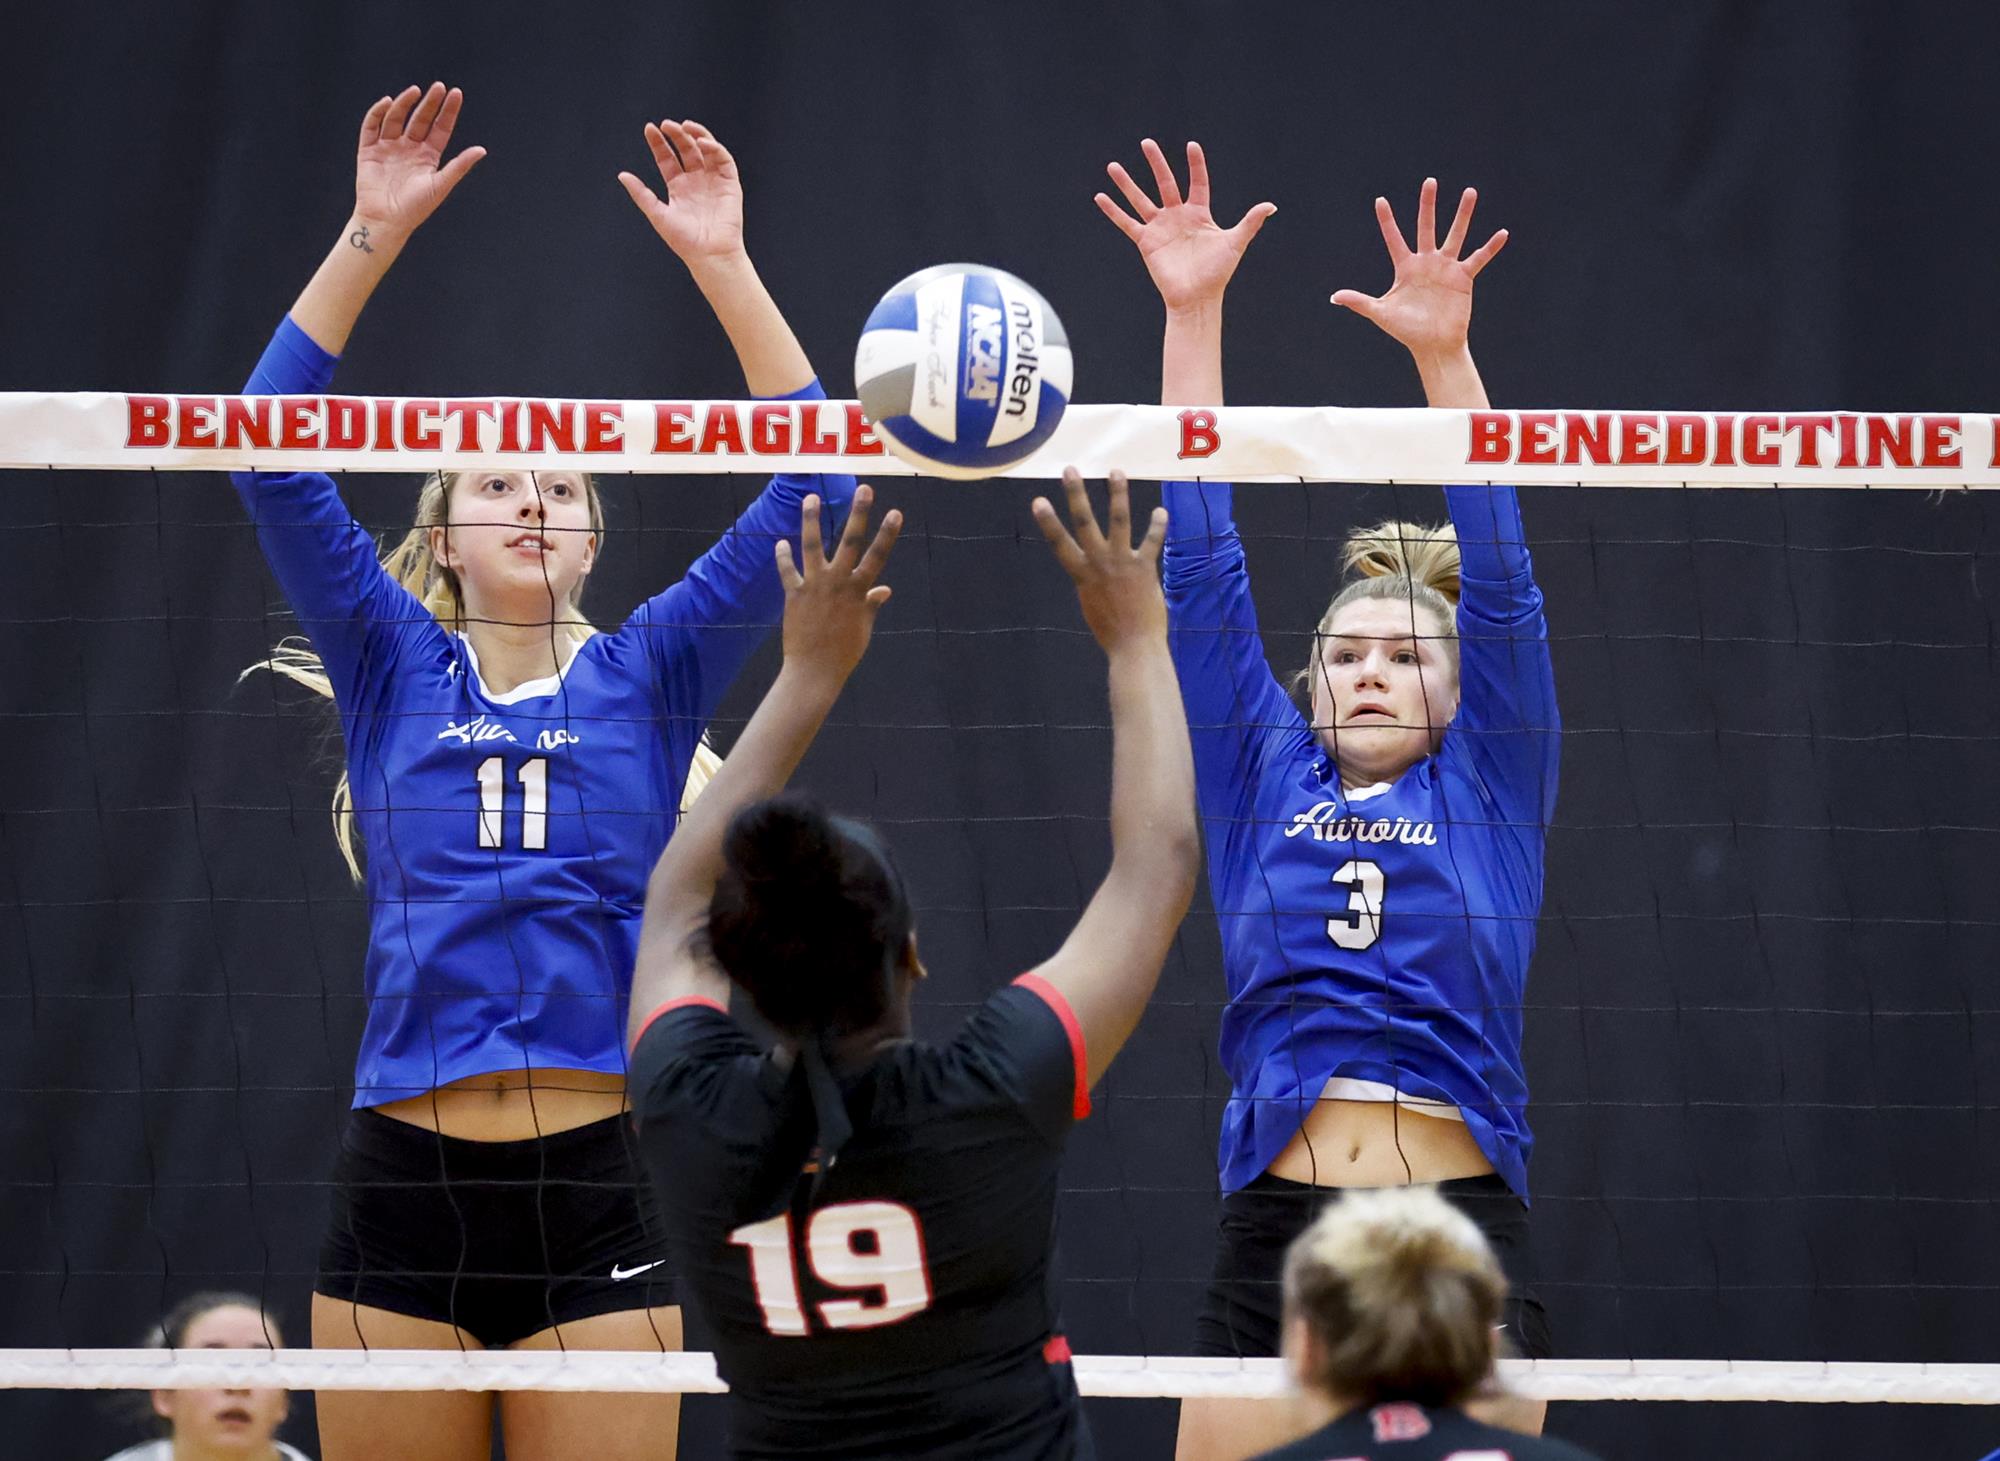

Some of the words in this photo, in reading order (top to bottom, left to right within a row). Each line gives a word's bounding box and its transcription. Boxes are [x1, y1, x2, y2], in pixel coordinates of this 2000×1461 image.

[965, 303, 1002, 407] NCAA
[1005, 301, 1040, 417] molten
[124, 394, 624, 455] BENEDICTINE
[651, 402, 894, 456] EAGLE
[1176, 408, 1221, 460] B
[1465, 412, 1962, 469] BENEDICTINE
[438, 714, 580, 750] Aurra
[476, 757, 548, 850] 11
[1284, 801, 1438, 846] Aurora
[1325, 859, 1386, 951] 3
[727, 1200, 933, 1337] 19
